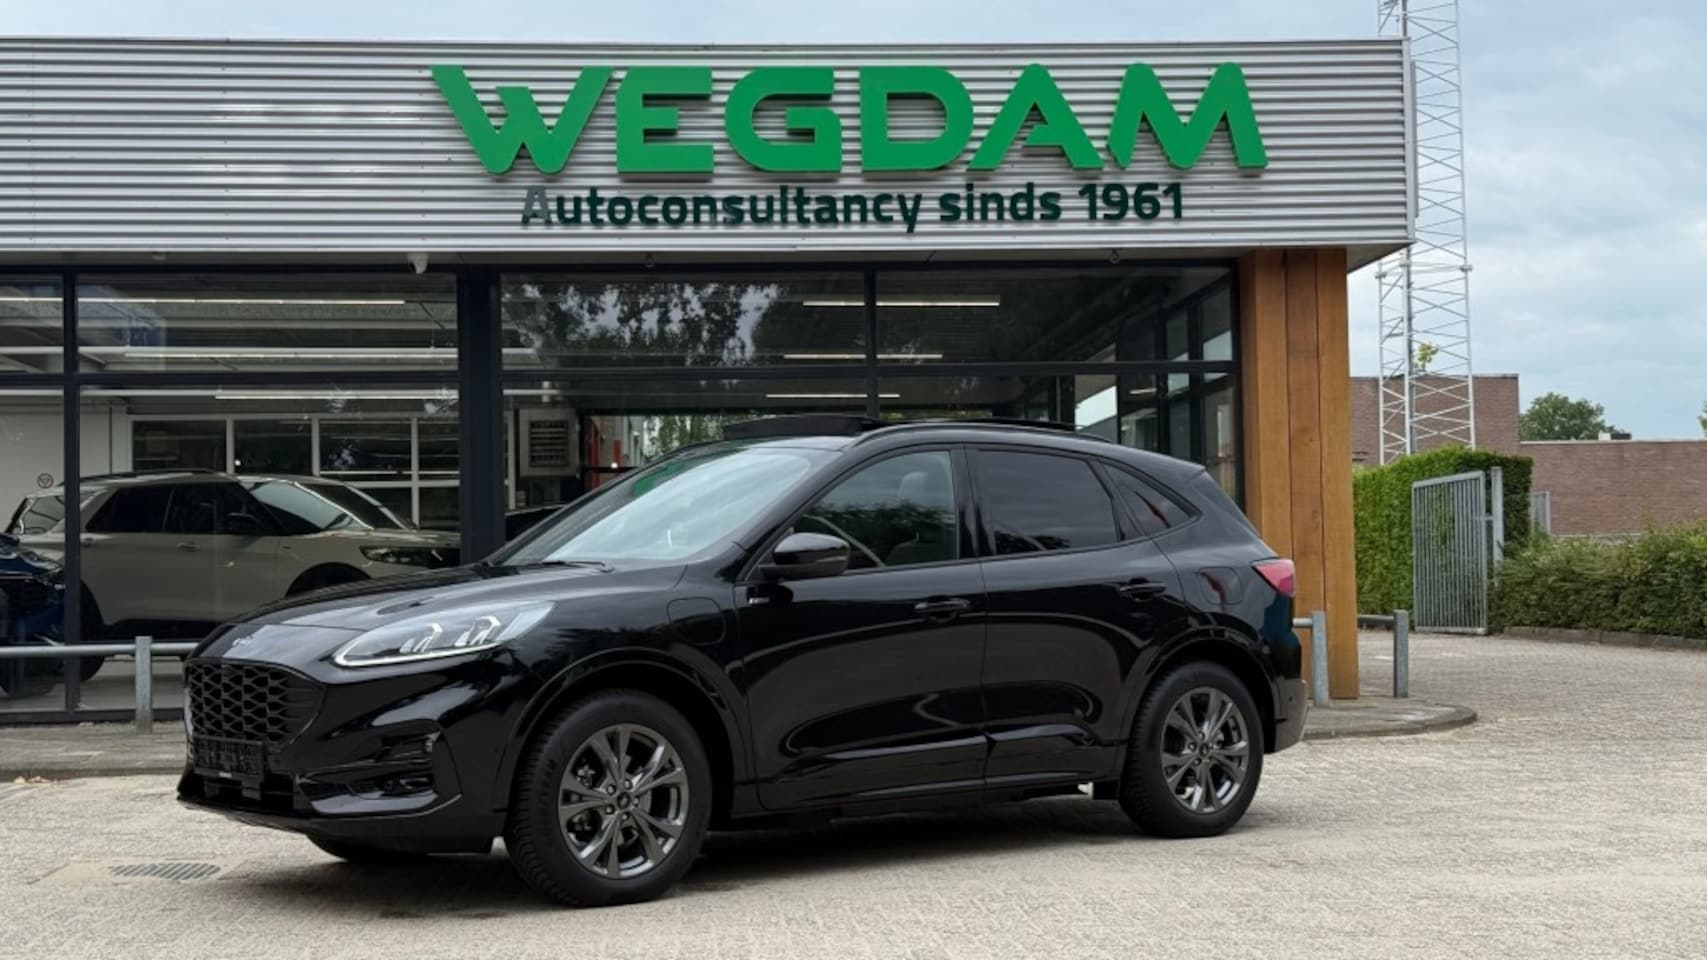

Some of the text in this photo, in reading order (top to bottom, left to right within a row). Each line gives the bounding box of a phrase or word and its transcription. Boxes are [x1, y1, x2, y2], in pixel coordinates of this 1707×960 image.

[431, 62, 1268, 175] WEGDAM
[523, 182, 1183, 233] Autoconsultancy sinds 1961
